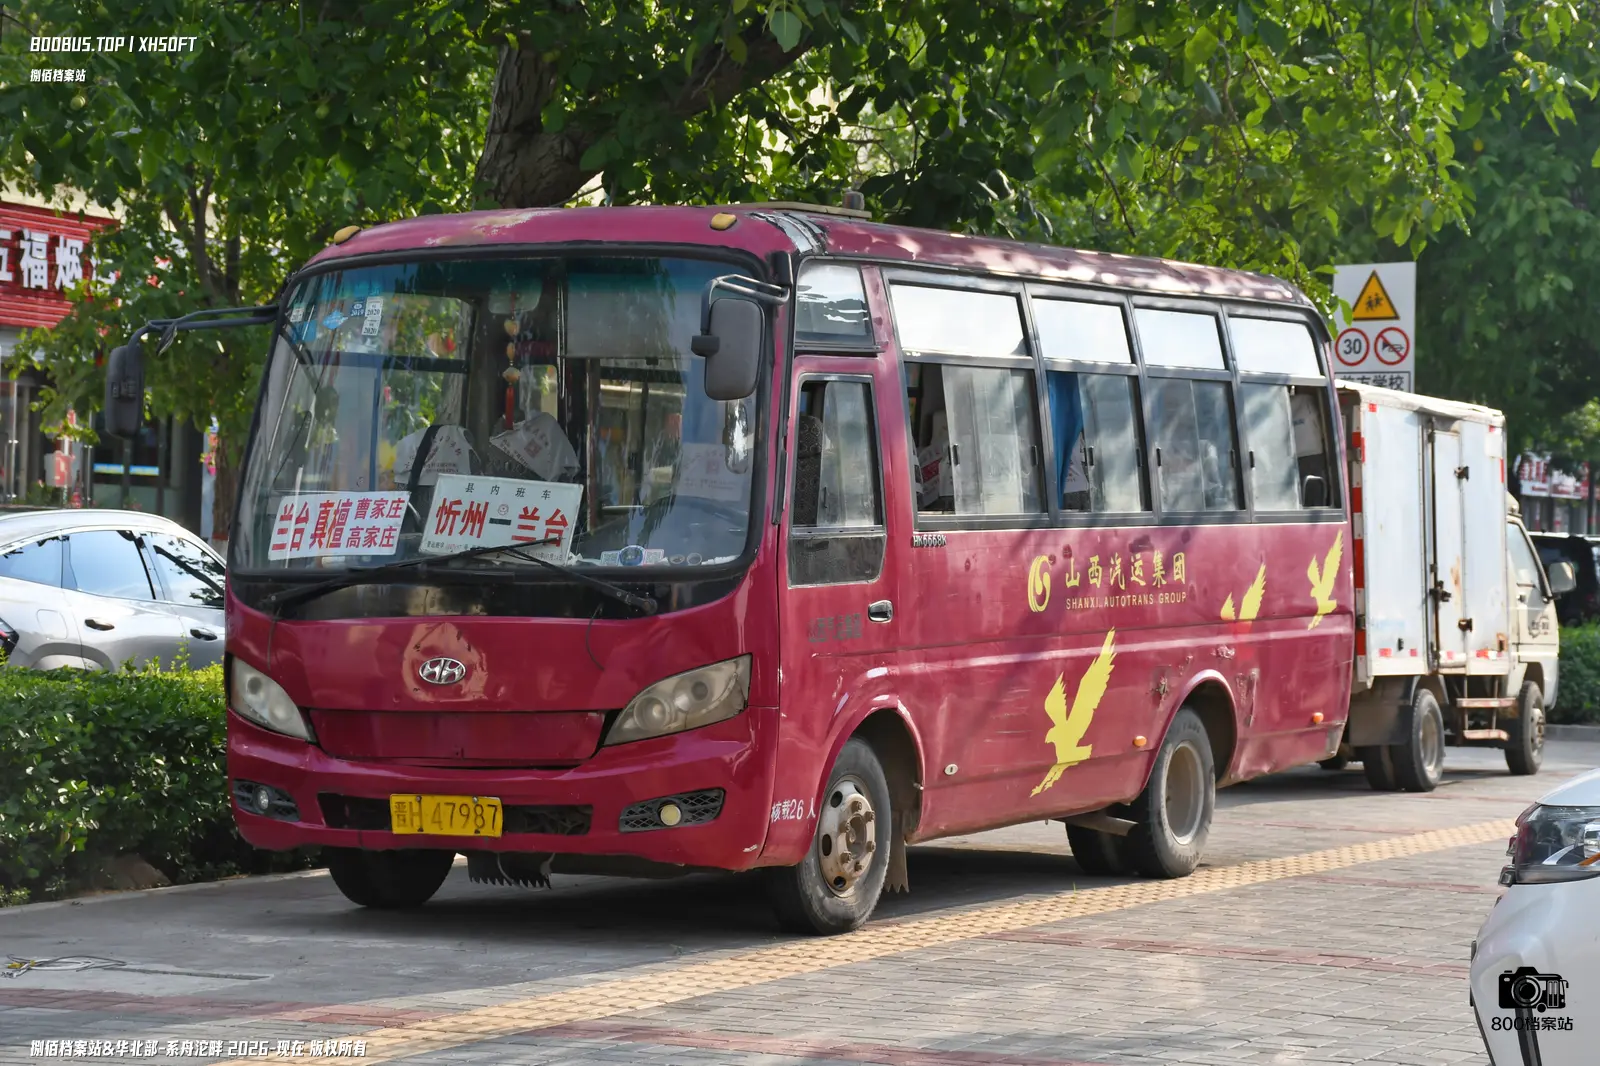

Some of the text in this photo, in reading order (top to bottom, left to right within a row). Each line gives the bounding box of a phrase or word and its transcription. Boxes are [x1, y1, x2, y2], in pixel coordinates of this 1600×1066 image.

[0, 227, 118, 295] 福烟
[1343, 338, 1363, 355] 30
[465, 482, 552, 501] 县内班车
[354, 497, 406, 520] 曹家庄
[346, 525, 398, 549] 高家庄
[1065, 550, 1186, 591] 山西汽运集团
[1065, 591, 1187, 610] SHANXI AUTOTRANS GROUP
